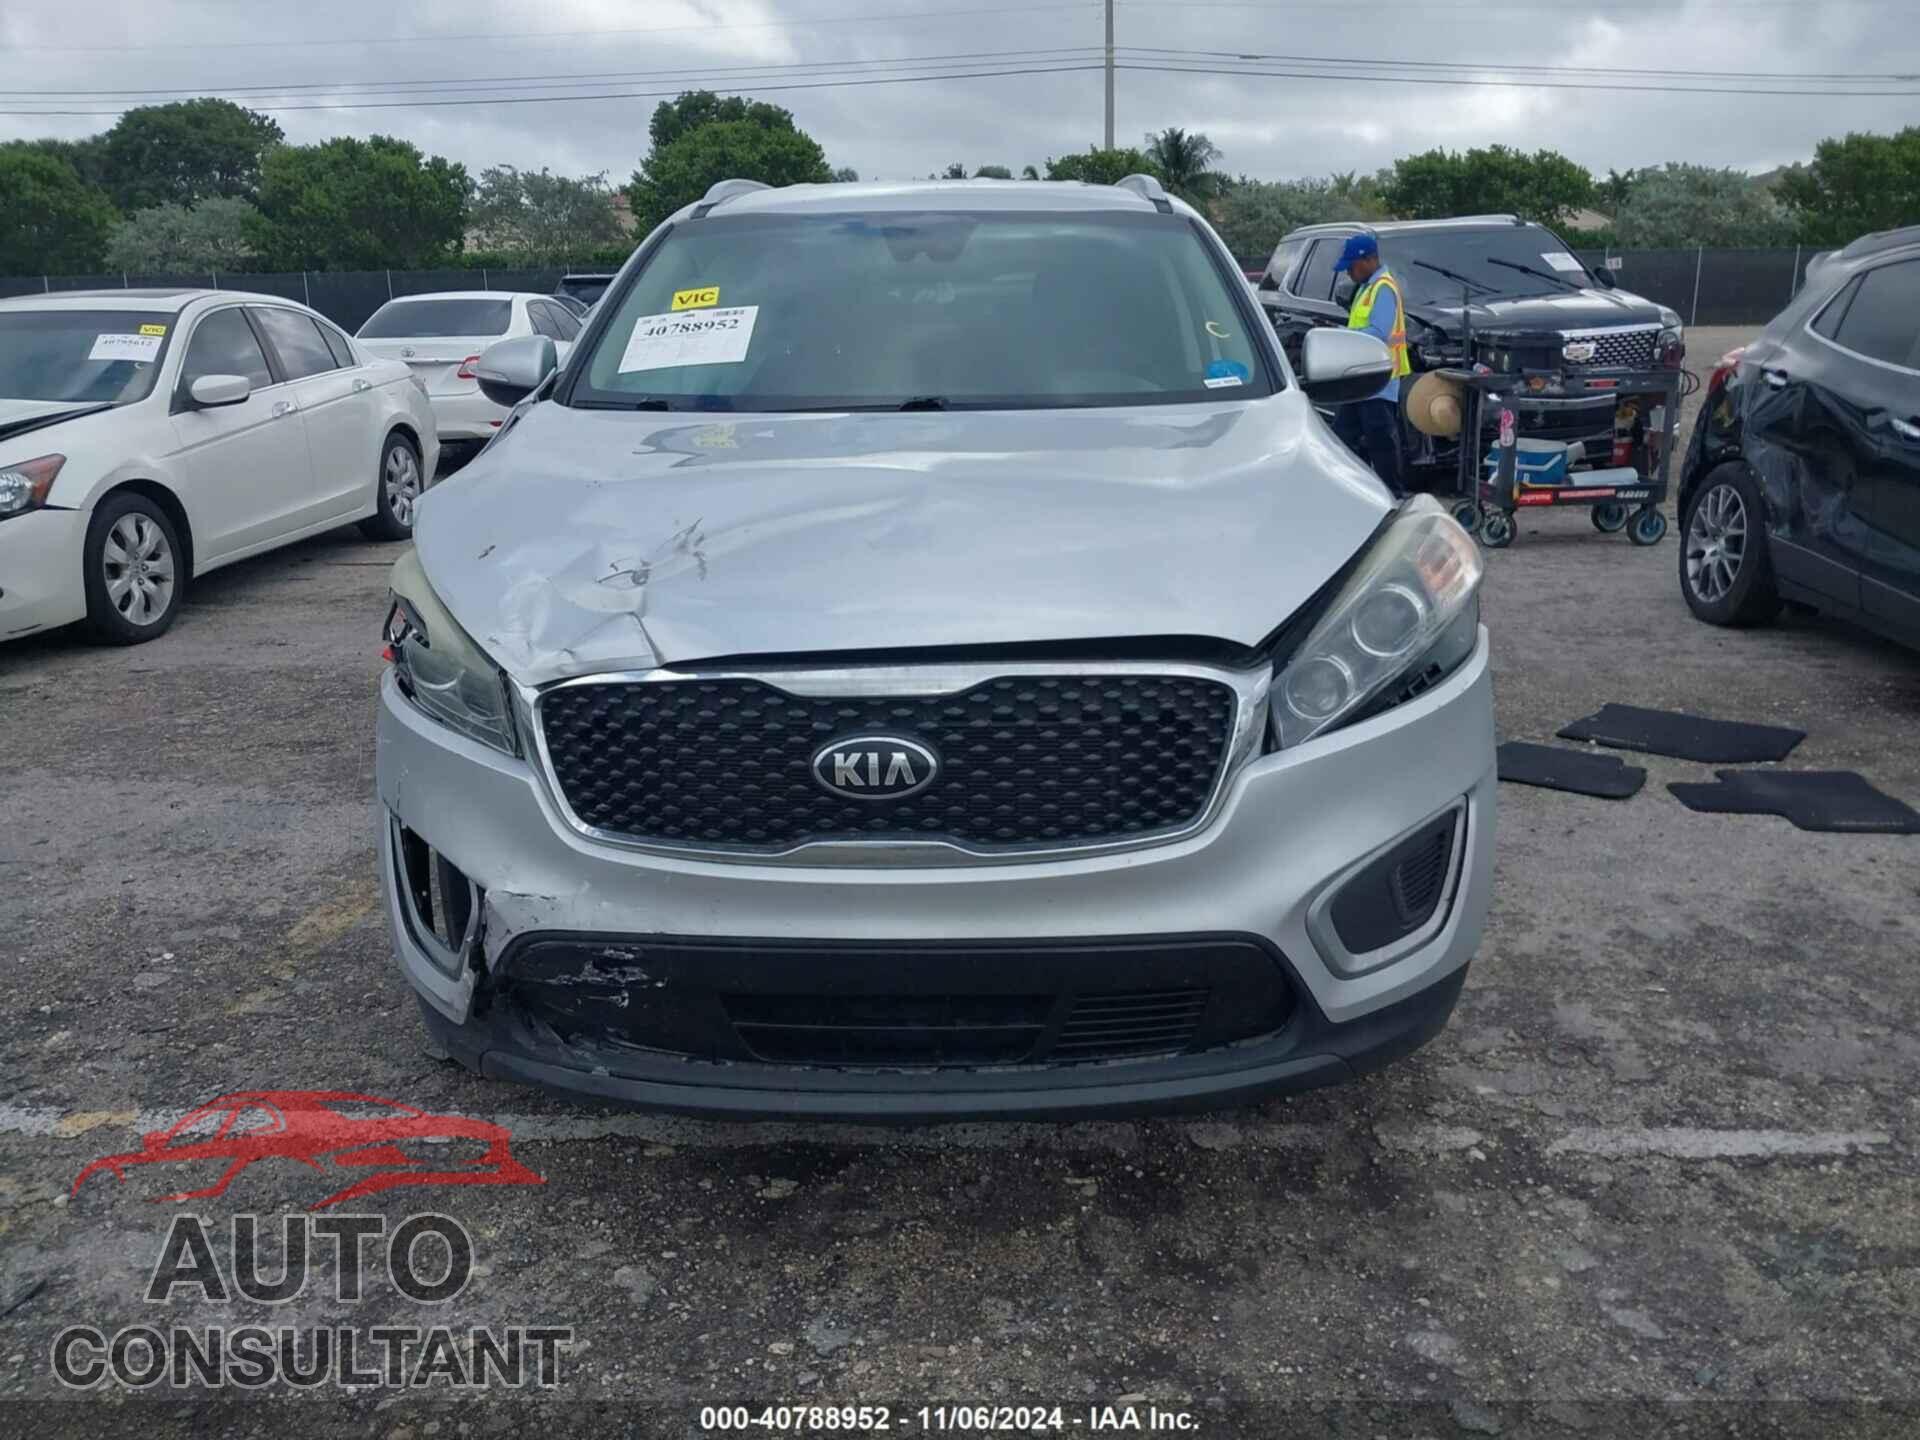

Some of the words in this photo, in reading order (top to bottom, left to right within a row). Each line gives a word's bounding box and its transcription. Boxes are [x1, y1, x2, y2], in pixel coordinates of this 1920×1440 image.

[677, 291, 715, 305] VIC
[643, 318, 739, 337] 40788952
[833, 752, 917, 786] KIA
